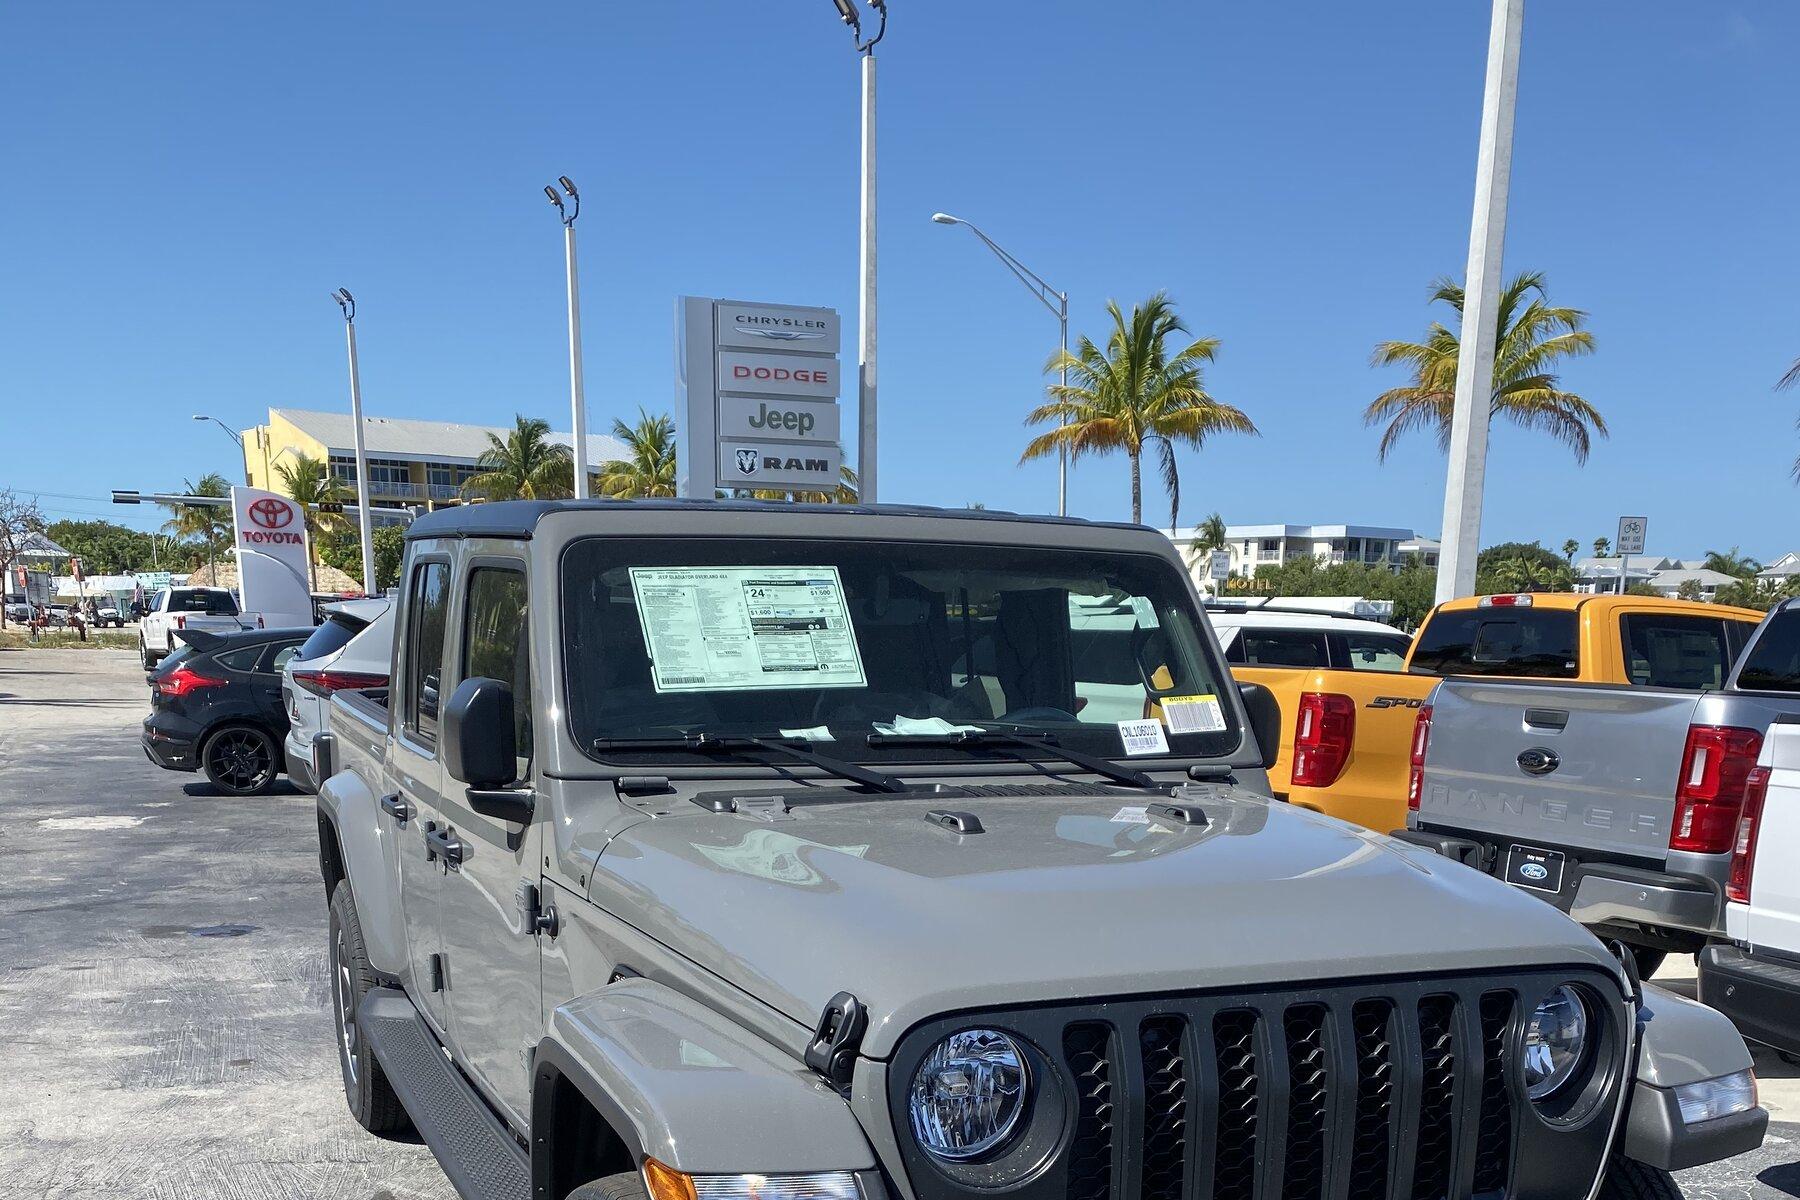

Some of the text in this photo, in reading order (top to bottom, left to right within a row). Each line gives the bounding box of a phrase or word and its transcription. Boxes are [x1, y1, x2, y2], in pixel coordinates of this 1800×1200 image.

[735, 315, 826, 329] CHRYSLER
[733, 366, 828, 383] DODGE
[748, 403, 815, 436] Jeep
[763, 457, 828, 472] RAM
[242, 531, 303, 545] TOYOTA
[750, 588, 765, 598] 24
[1365, 696, 1425, 709] SPO
[1430, 783, 1661, 836] RANGER
